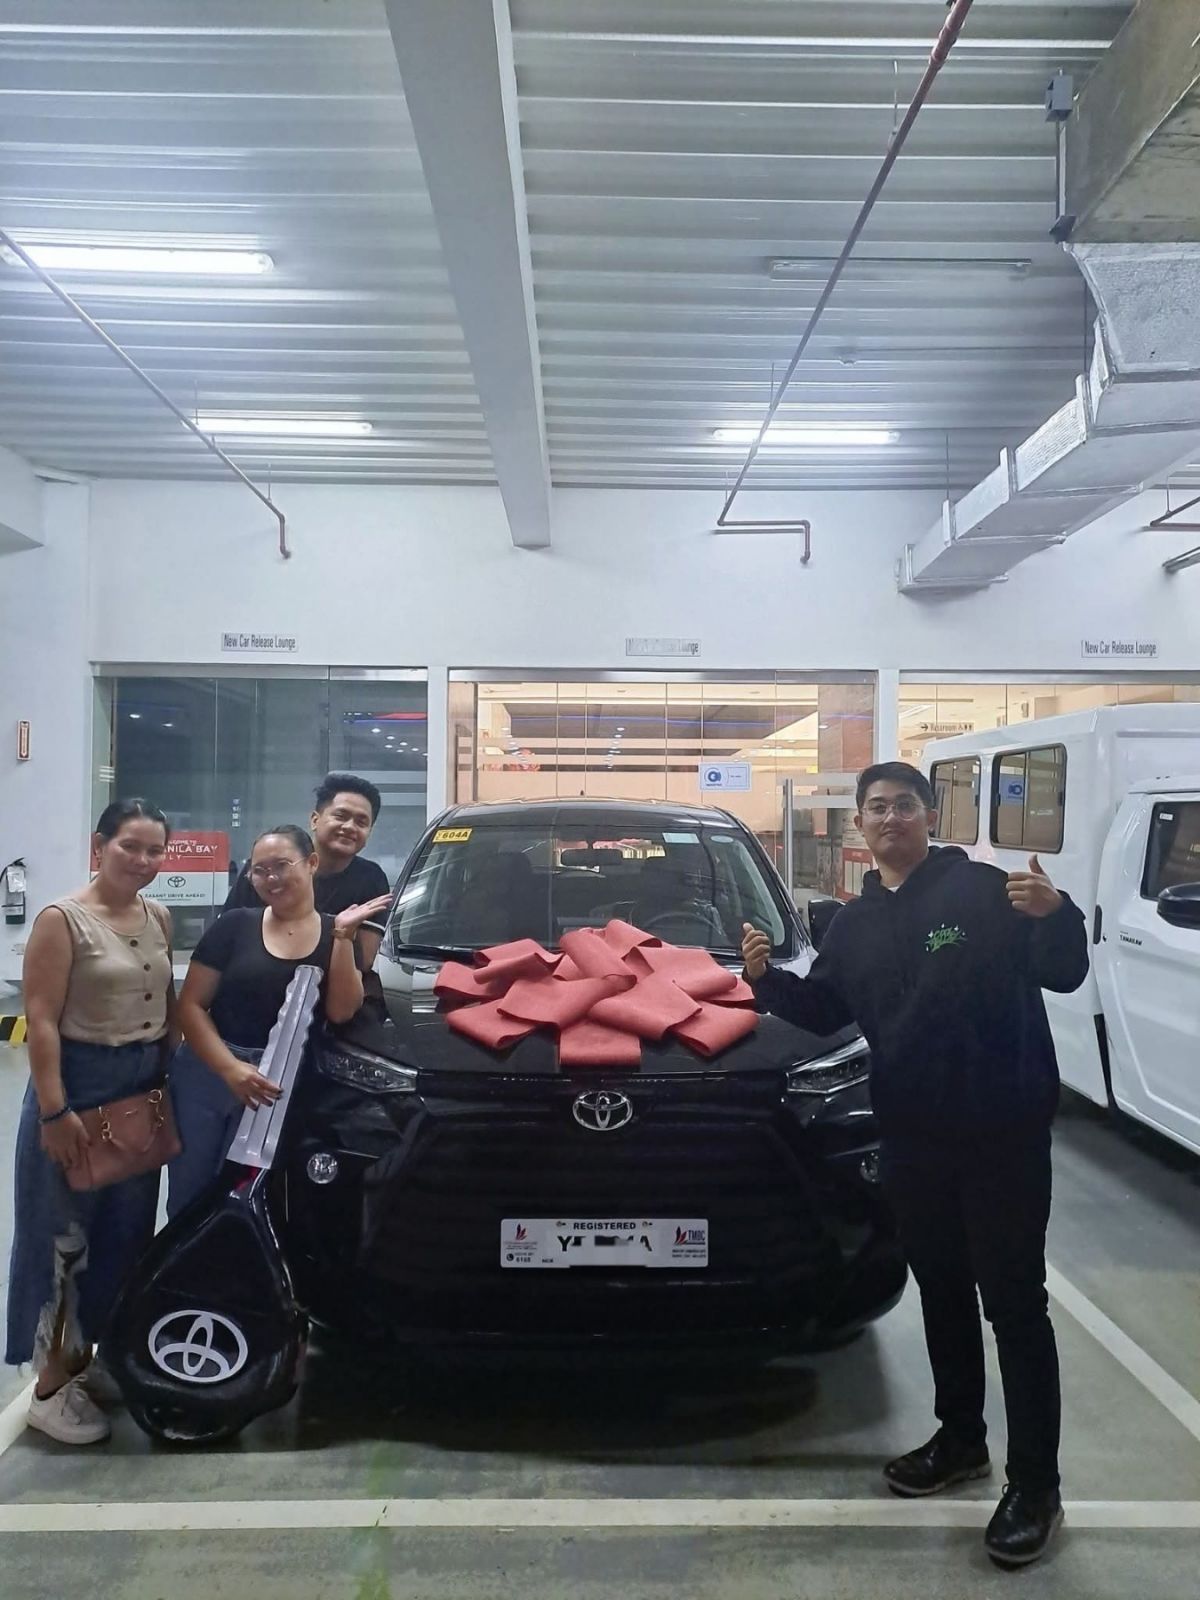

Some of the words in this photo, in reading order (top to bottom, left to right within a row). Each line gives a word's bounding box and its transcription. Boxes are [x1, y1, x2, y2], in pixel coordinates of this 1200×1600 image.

[224, 634, 238, 647] New
[240, 634, 250, 648] Car
[251, 634, 274, 648] Release
[275, 634, 296, 651] Lounge
[1085, 641, 1098, 654] New
[1100, 641, 1110, 654] Car
[1111, 641, 1134, 654] Release
[1135, 641, 1157, 656] Lounge
[196, 845, 218, 853] BAY
[573, 1222, 636, 1230] REGISTERED
